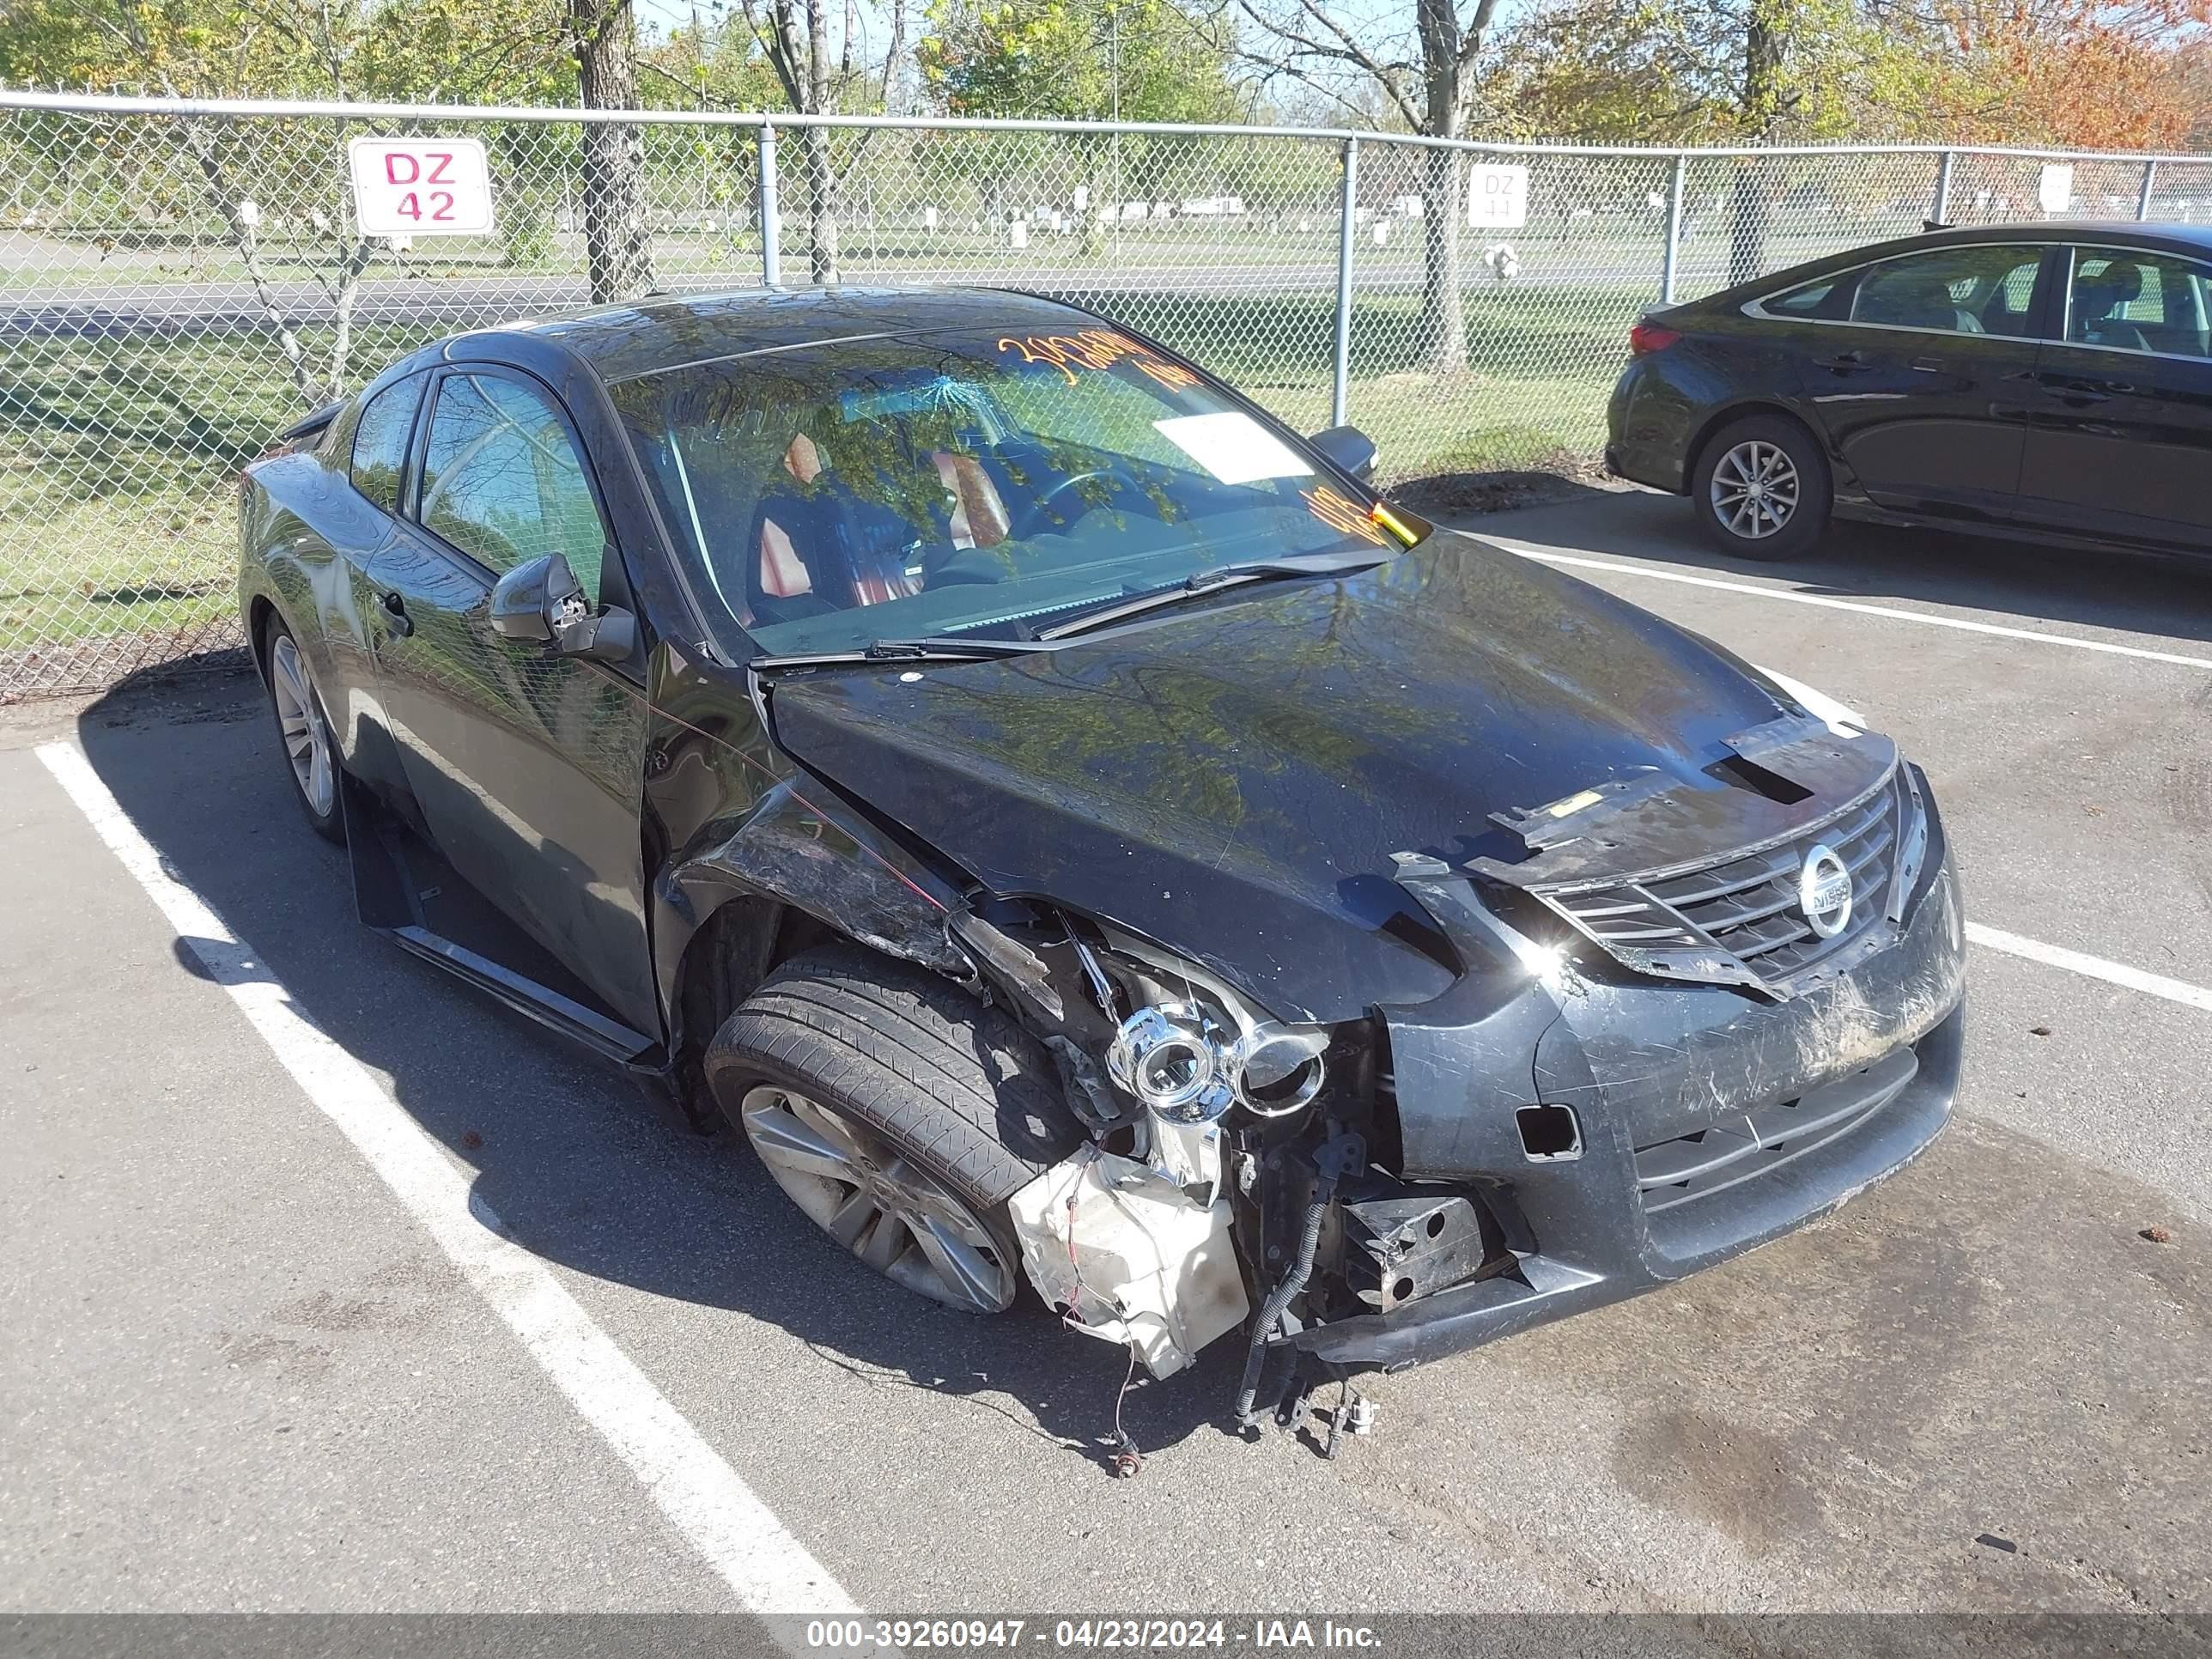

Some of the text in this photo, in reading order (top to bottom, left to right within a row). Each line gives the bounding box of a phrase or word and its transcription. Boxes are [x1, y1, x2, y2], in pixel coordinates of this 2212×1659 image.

[385, 154, 456, 185] DZ
[1486, 174, 1514, 195] DZ
[397, 191, 456, 222] 42
